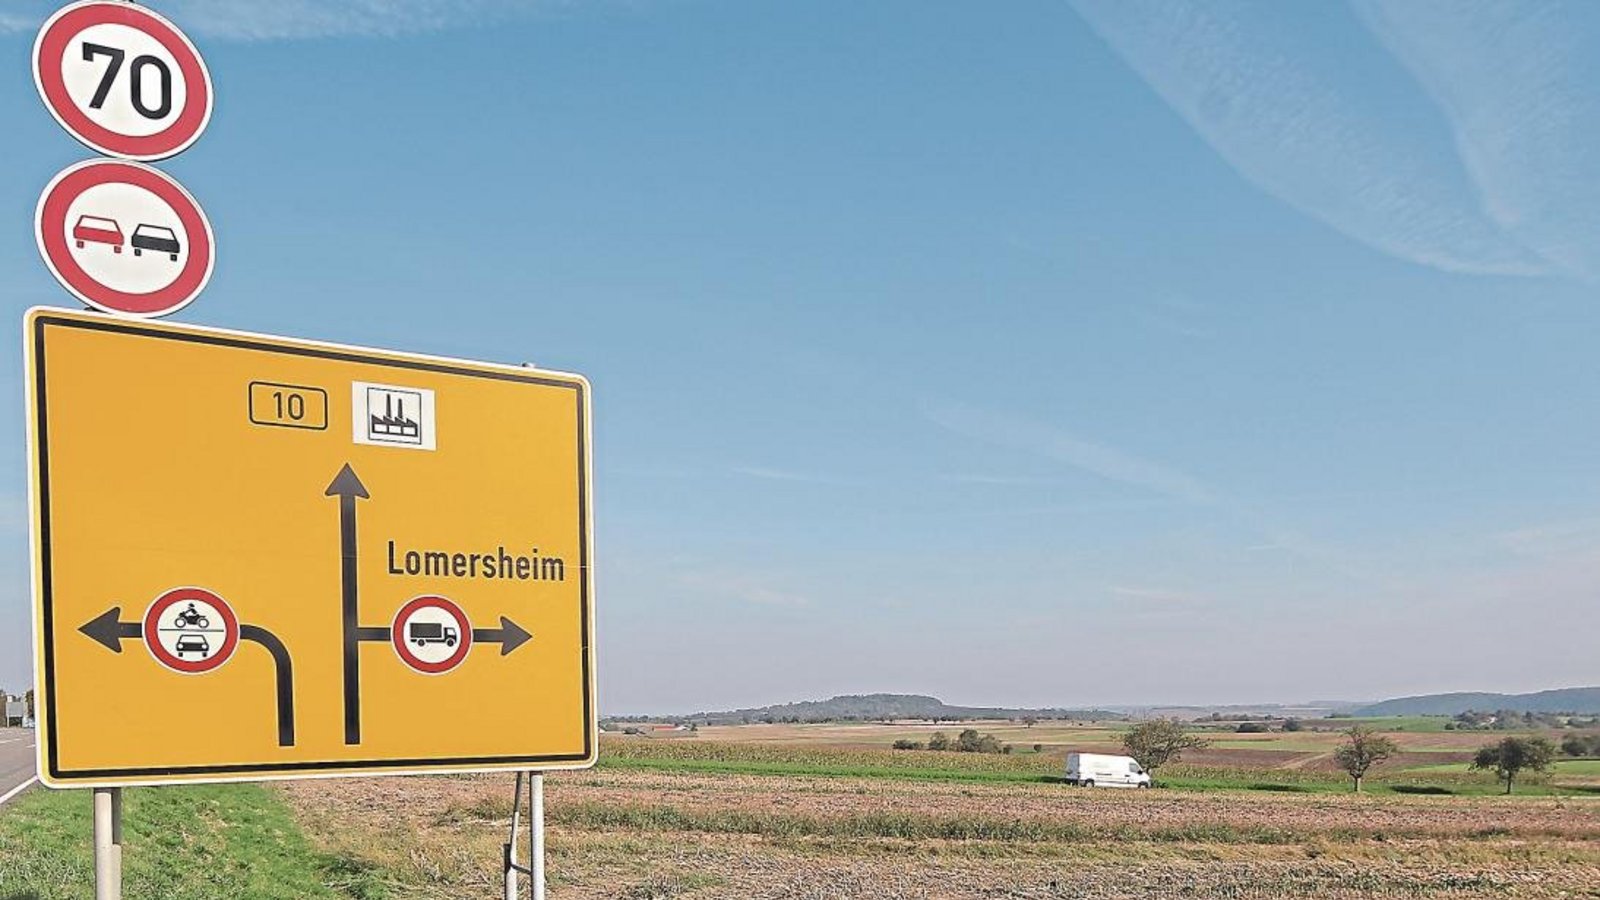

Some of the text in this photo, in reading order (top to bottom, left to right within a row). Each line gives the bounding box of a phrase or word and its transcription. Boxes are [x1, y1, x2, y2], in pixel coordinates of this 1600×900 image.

[82, 41, 172, 120] 70
[272, 391, 305, 421] 10
[388, 540, 565, 582] Lomersheim
